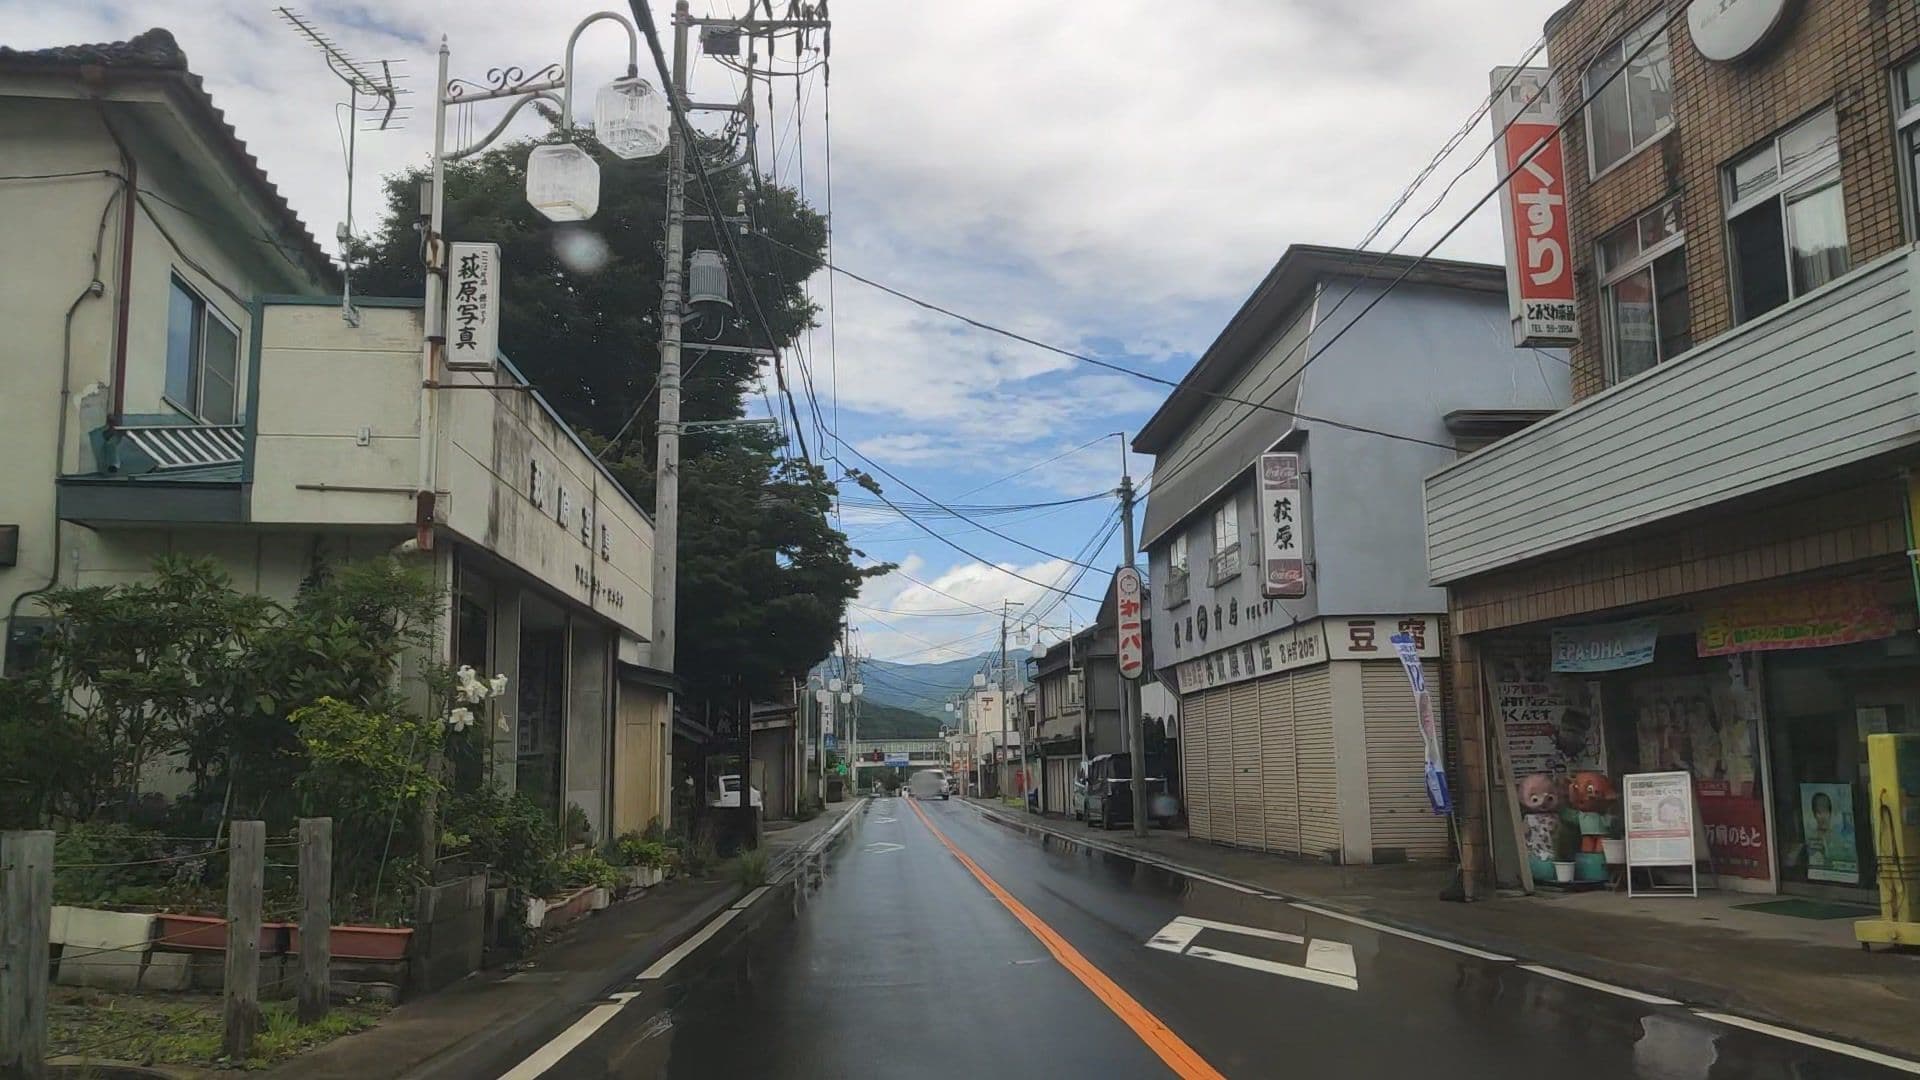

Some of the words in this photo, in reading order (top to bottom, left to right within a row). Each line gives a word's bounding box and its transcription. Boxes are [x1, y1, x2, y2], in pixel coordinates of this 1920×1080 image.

[1517, 137, 1564, 286] くすり
[456, 253, 480, 350] 萩原写真
[1273, 497, 1294, 550] 萩原
